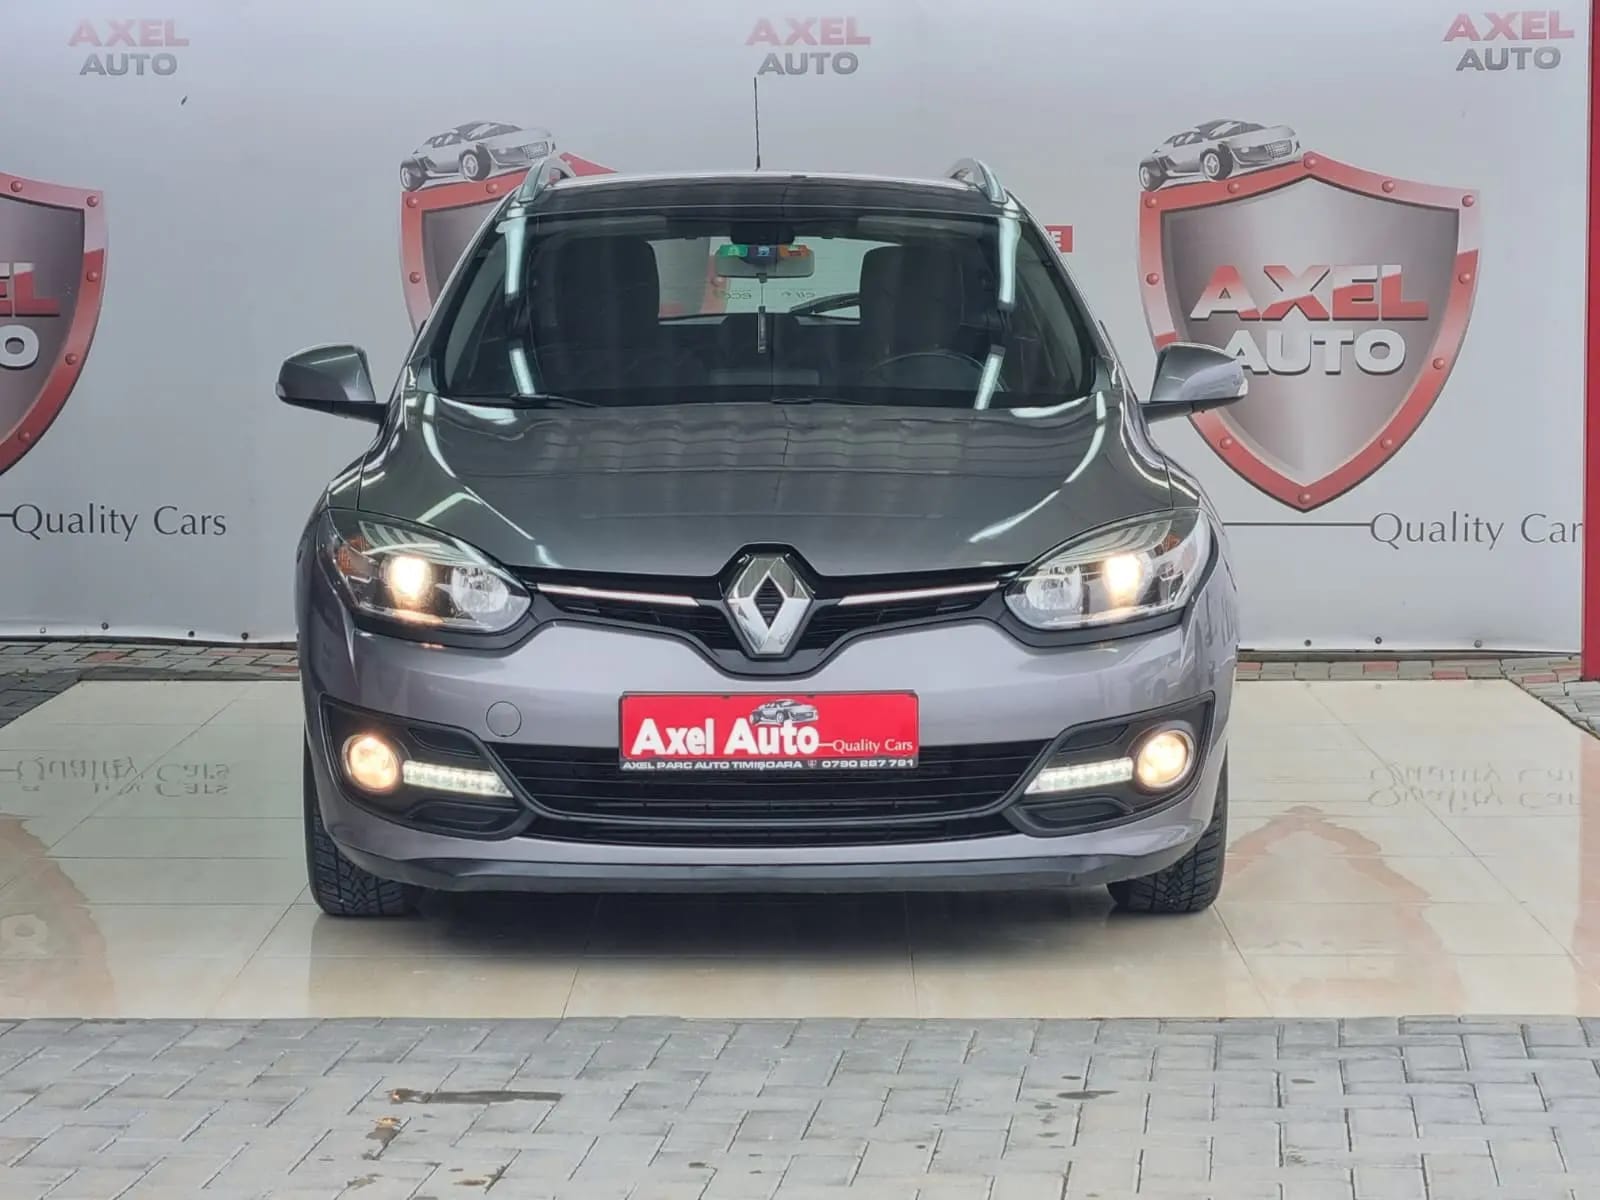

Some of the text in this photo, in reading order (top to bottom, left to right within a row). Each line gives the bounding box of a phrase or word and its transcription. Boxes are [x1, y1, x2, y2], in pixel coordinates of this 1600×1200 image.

[67, 18, 190, 47] AXEL
[744, 16, 872, 46] AXEL
[1442, 10, 1575, 42] AXEL
[79, 52, 178, 76] AUTO
[756, 52, 859, 75] AUTO
[1455, 46, 1561, 71] AUTO
[1189, 264, 1429, 321] AXEL
[1223, 328, 1407, 376] AUTO
[12, 503, 227, 542] Quality Cars
[1369, 510, 1505, 550] Quality
[631, 718, 820, 755] Axel Auto
[832, 738, 914, 754] Quality Cars
[622, 761, 656, 771] AXEL
[656, 761, 693, 770] PARC
[694, 761, 730, 770] AUTO
